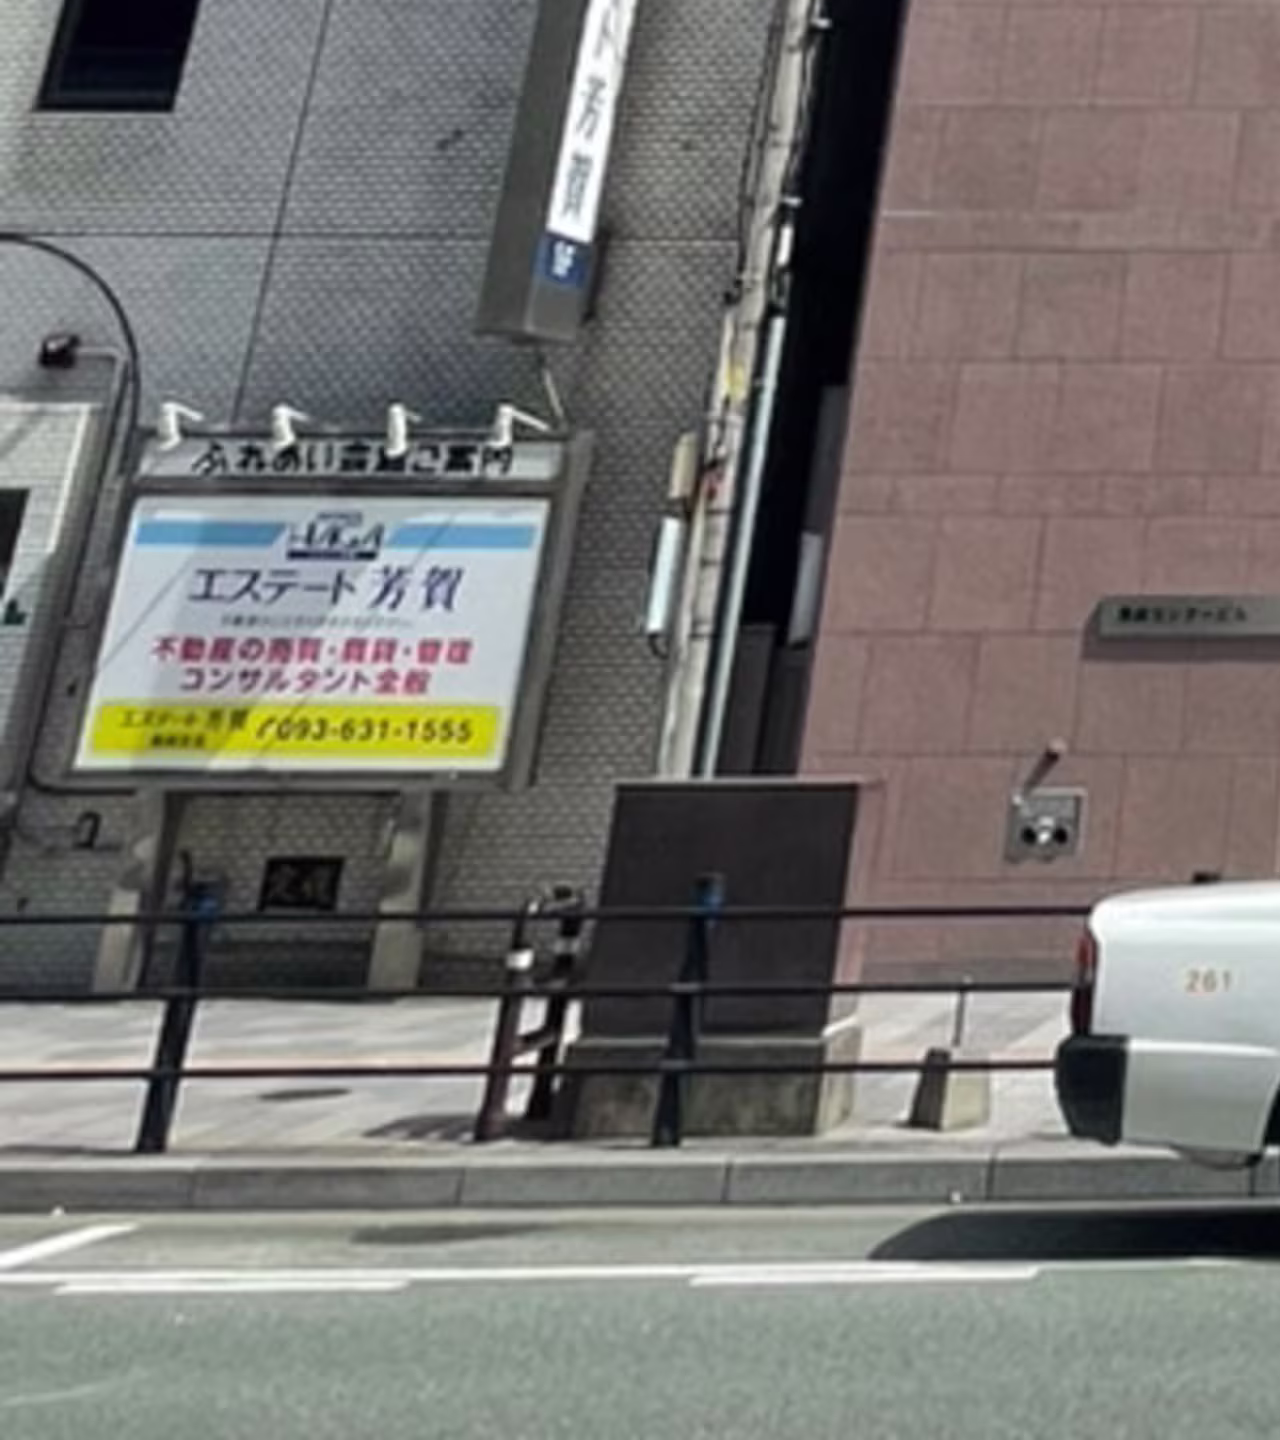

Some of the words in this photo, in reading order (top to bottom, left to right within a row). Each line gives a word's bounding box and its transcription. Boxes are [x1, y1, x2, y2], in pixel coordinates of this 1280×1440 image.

[188, 565, 464, 611] エステート芳賀
[181, 666, 432, 695] コンサルタント全般
[276, 717, 473, 743] 093-631-1555
